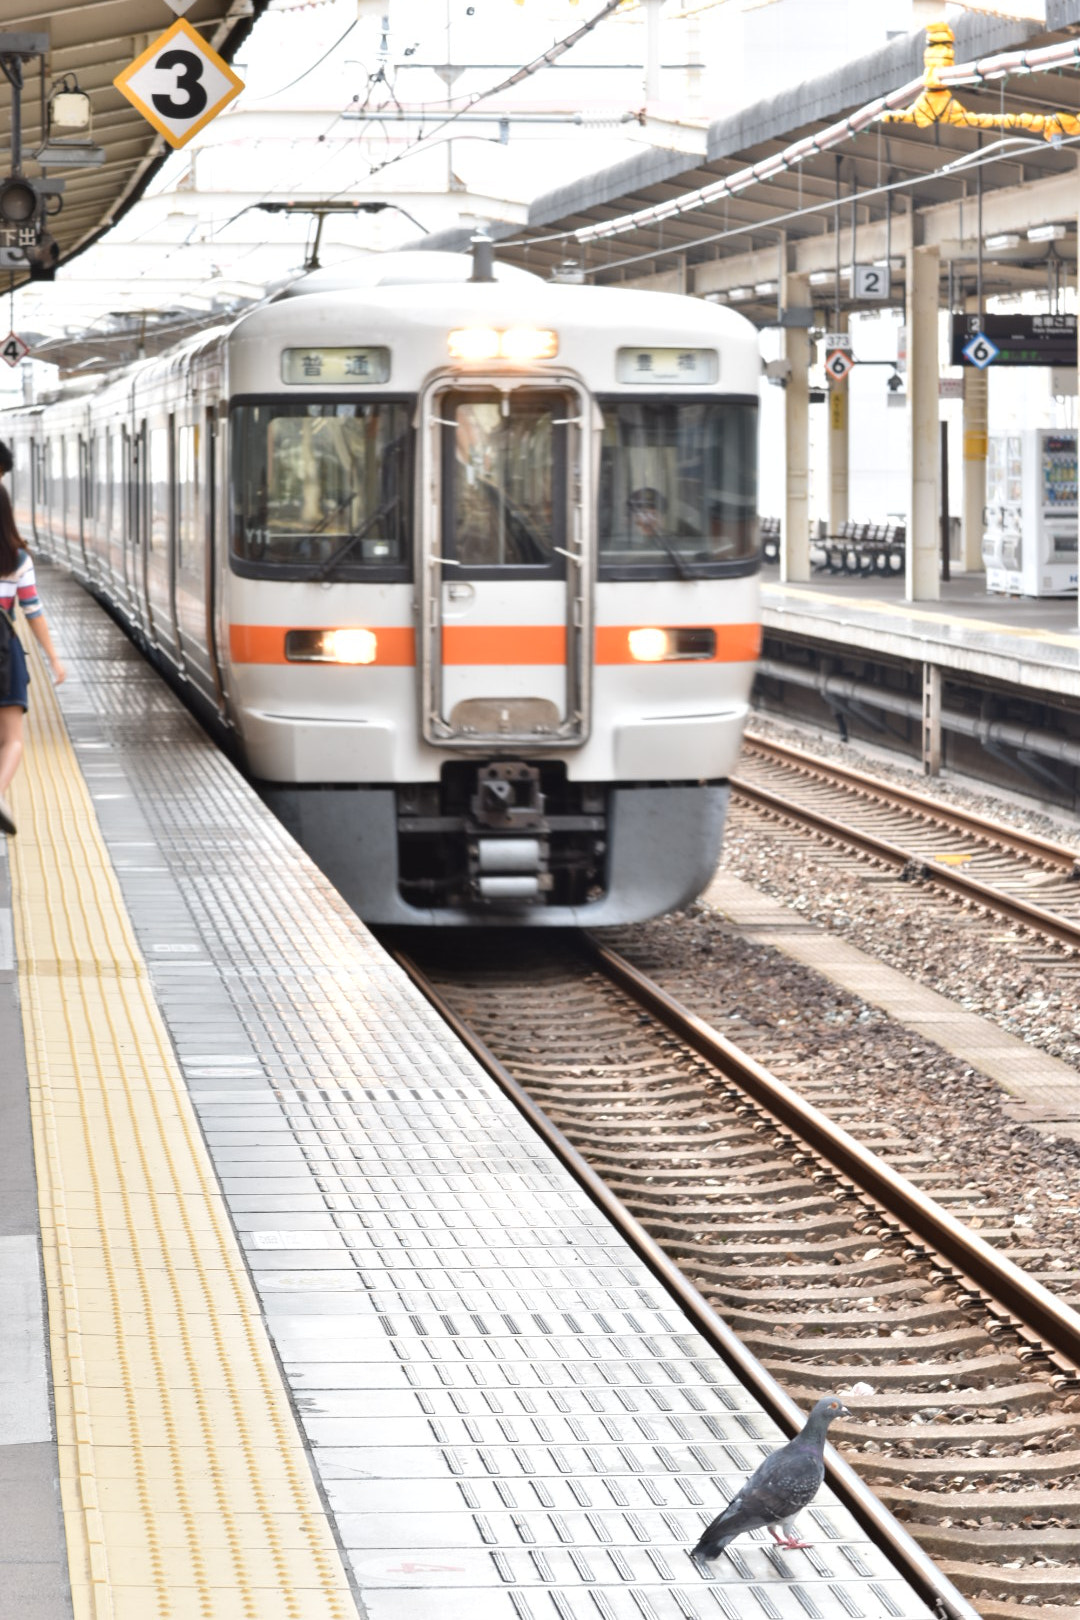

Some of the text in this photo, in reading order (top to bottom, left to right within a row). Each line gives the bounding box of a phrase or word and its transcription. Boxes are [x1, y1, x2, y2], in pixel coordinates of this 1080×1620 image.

[152, 50, 207, 119] 3
[864, 272, 879, 293] 2
[970, 318, 981, 331] 2
[3, 341, 19, 360] 4
[827, 336, 849, 347] 373
[973, 341, 988, 361] 6
[302, 355, 369, 377] 普通
[832, 356, 845, 375] 6
[245, 528, 271, 545] Y11
